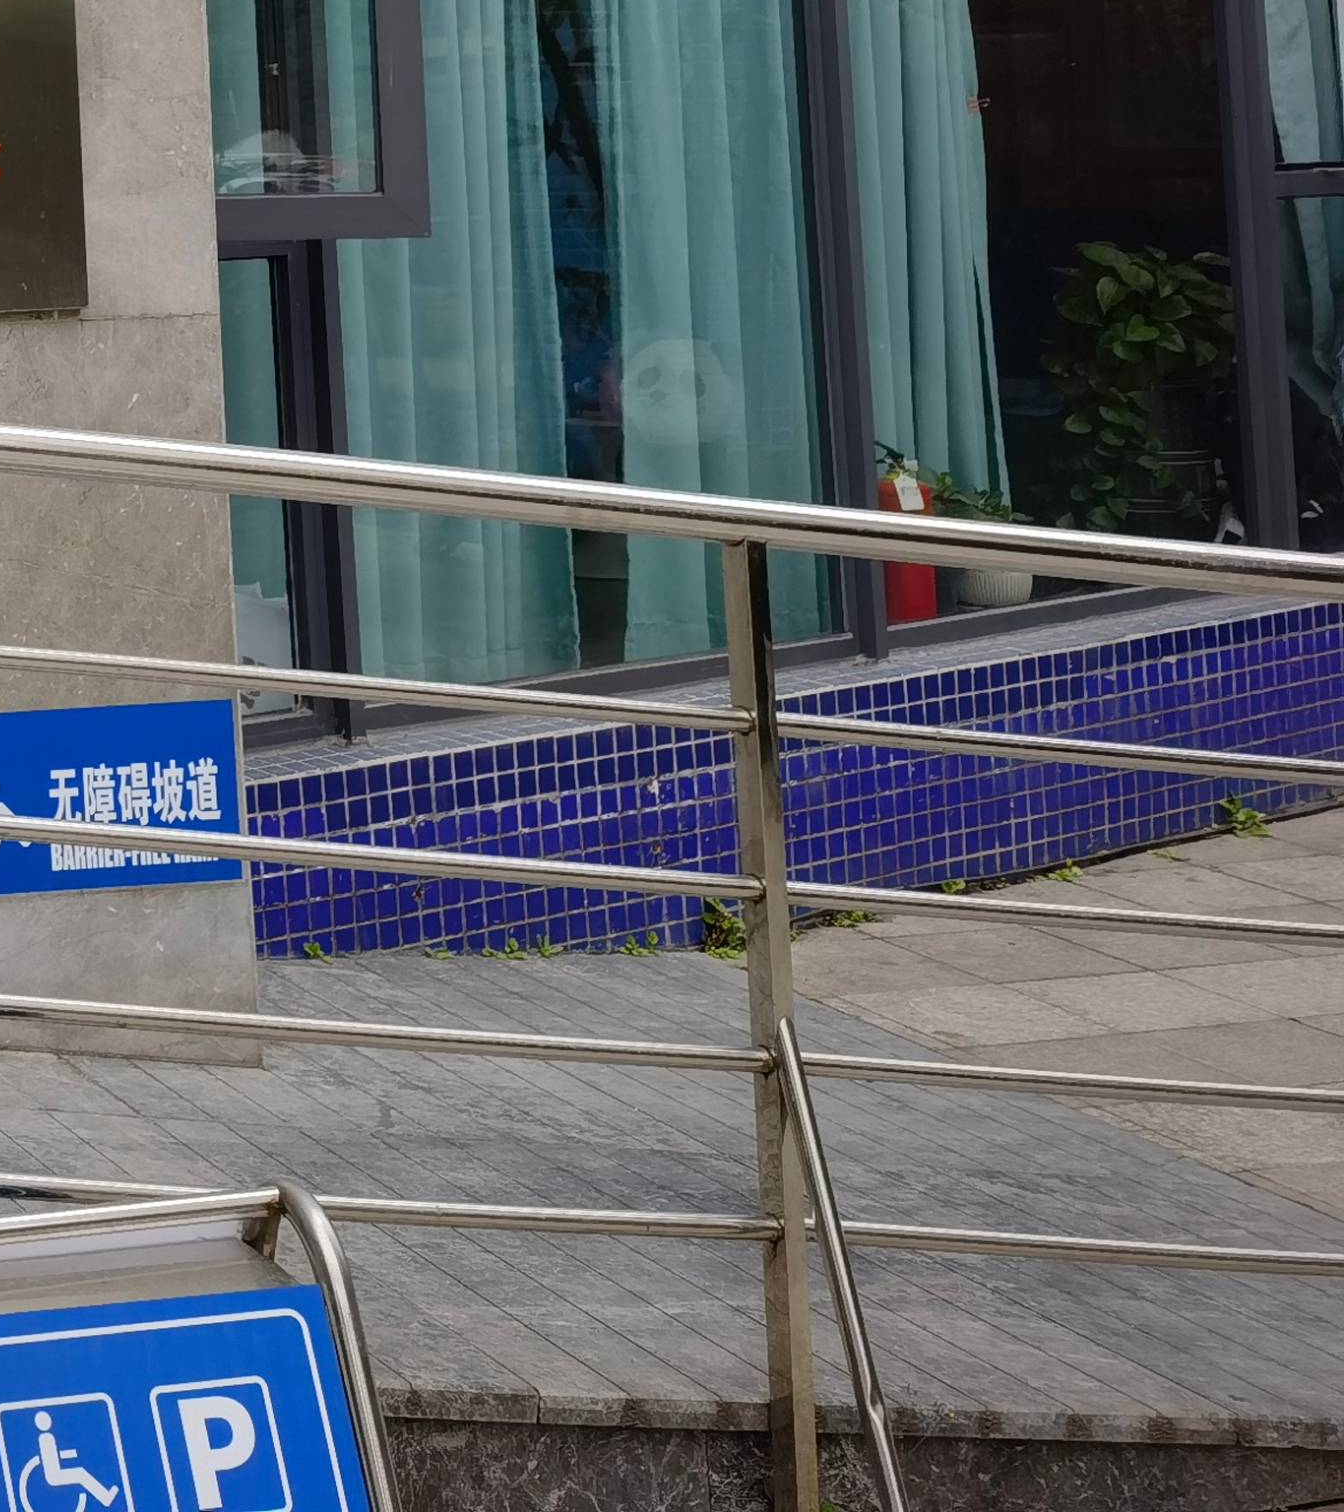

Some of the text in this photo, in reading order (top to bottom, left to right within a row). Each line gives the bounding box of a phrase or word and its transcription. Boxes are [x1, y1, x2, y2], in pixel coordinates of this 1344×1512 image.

[49, 757, 222, 826] 无障碍坡道
[177, 1395, 256, 1511] P
